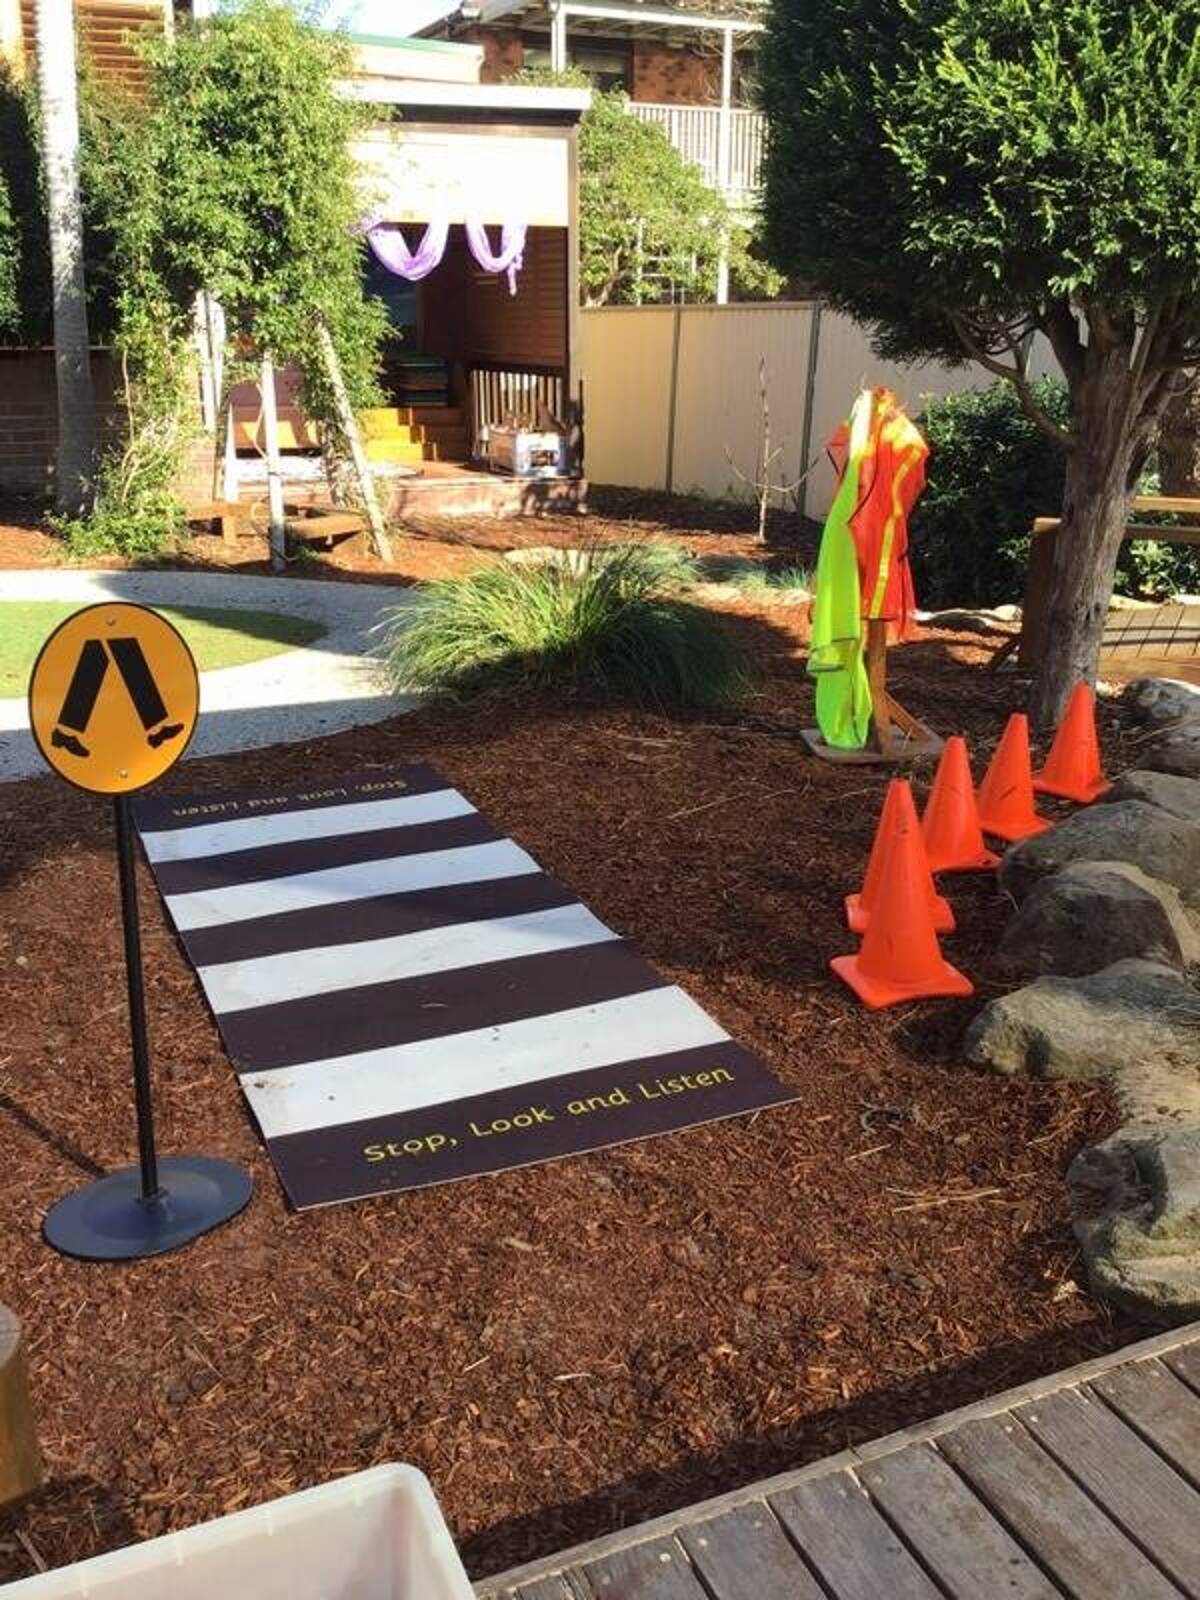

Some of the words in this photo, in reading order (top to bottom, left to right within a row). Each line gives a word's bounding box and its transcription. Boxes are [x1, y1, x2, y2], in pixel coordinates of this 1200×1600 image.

[363, 1132, 458, 1163] Stop,
[469, 1105, 555, 1137] Look
[567, 1086, 630, 1116] and
[637, 1066, 735, 1100] Listen
